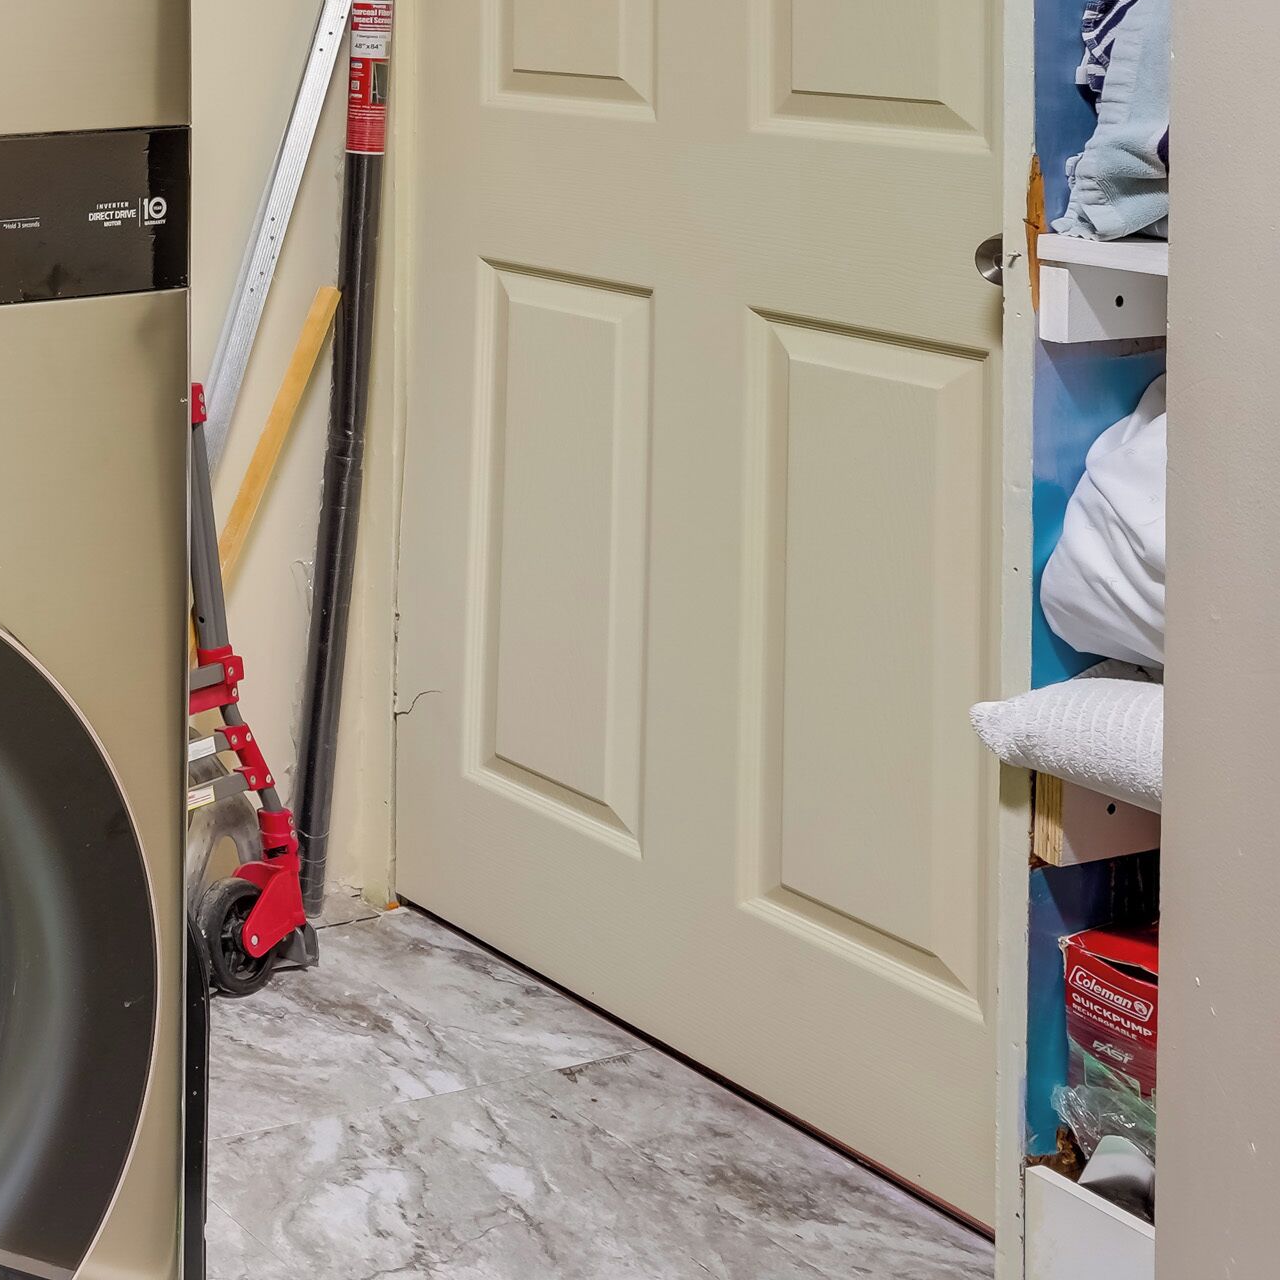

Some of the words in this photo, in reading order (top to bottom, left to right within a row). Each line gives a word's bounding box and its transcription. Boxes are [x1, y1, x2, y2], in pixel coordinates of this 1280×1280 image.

[88, 210, 115, 222] DIRECT
[114, 209, 137, 219] DRIVE
[96, 202, 129, 210] INVERTER
[143, 196, 167, 220] 10
[1075, 971, 1132, 1009] Coleman
[1072, 992, 1152, 1037] QUICKPUMP
[1072, 1002, 1137, 1040] RECHARGEABLE
[1092, 1040, 1135, 1064] FAST
